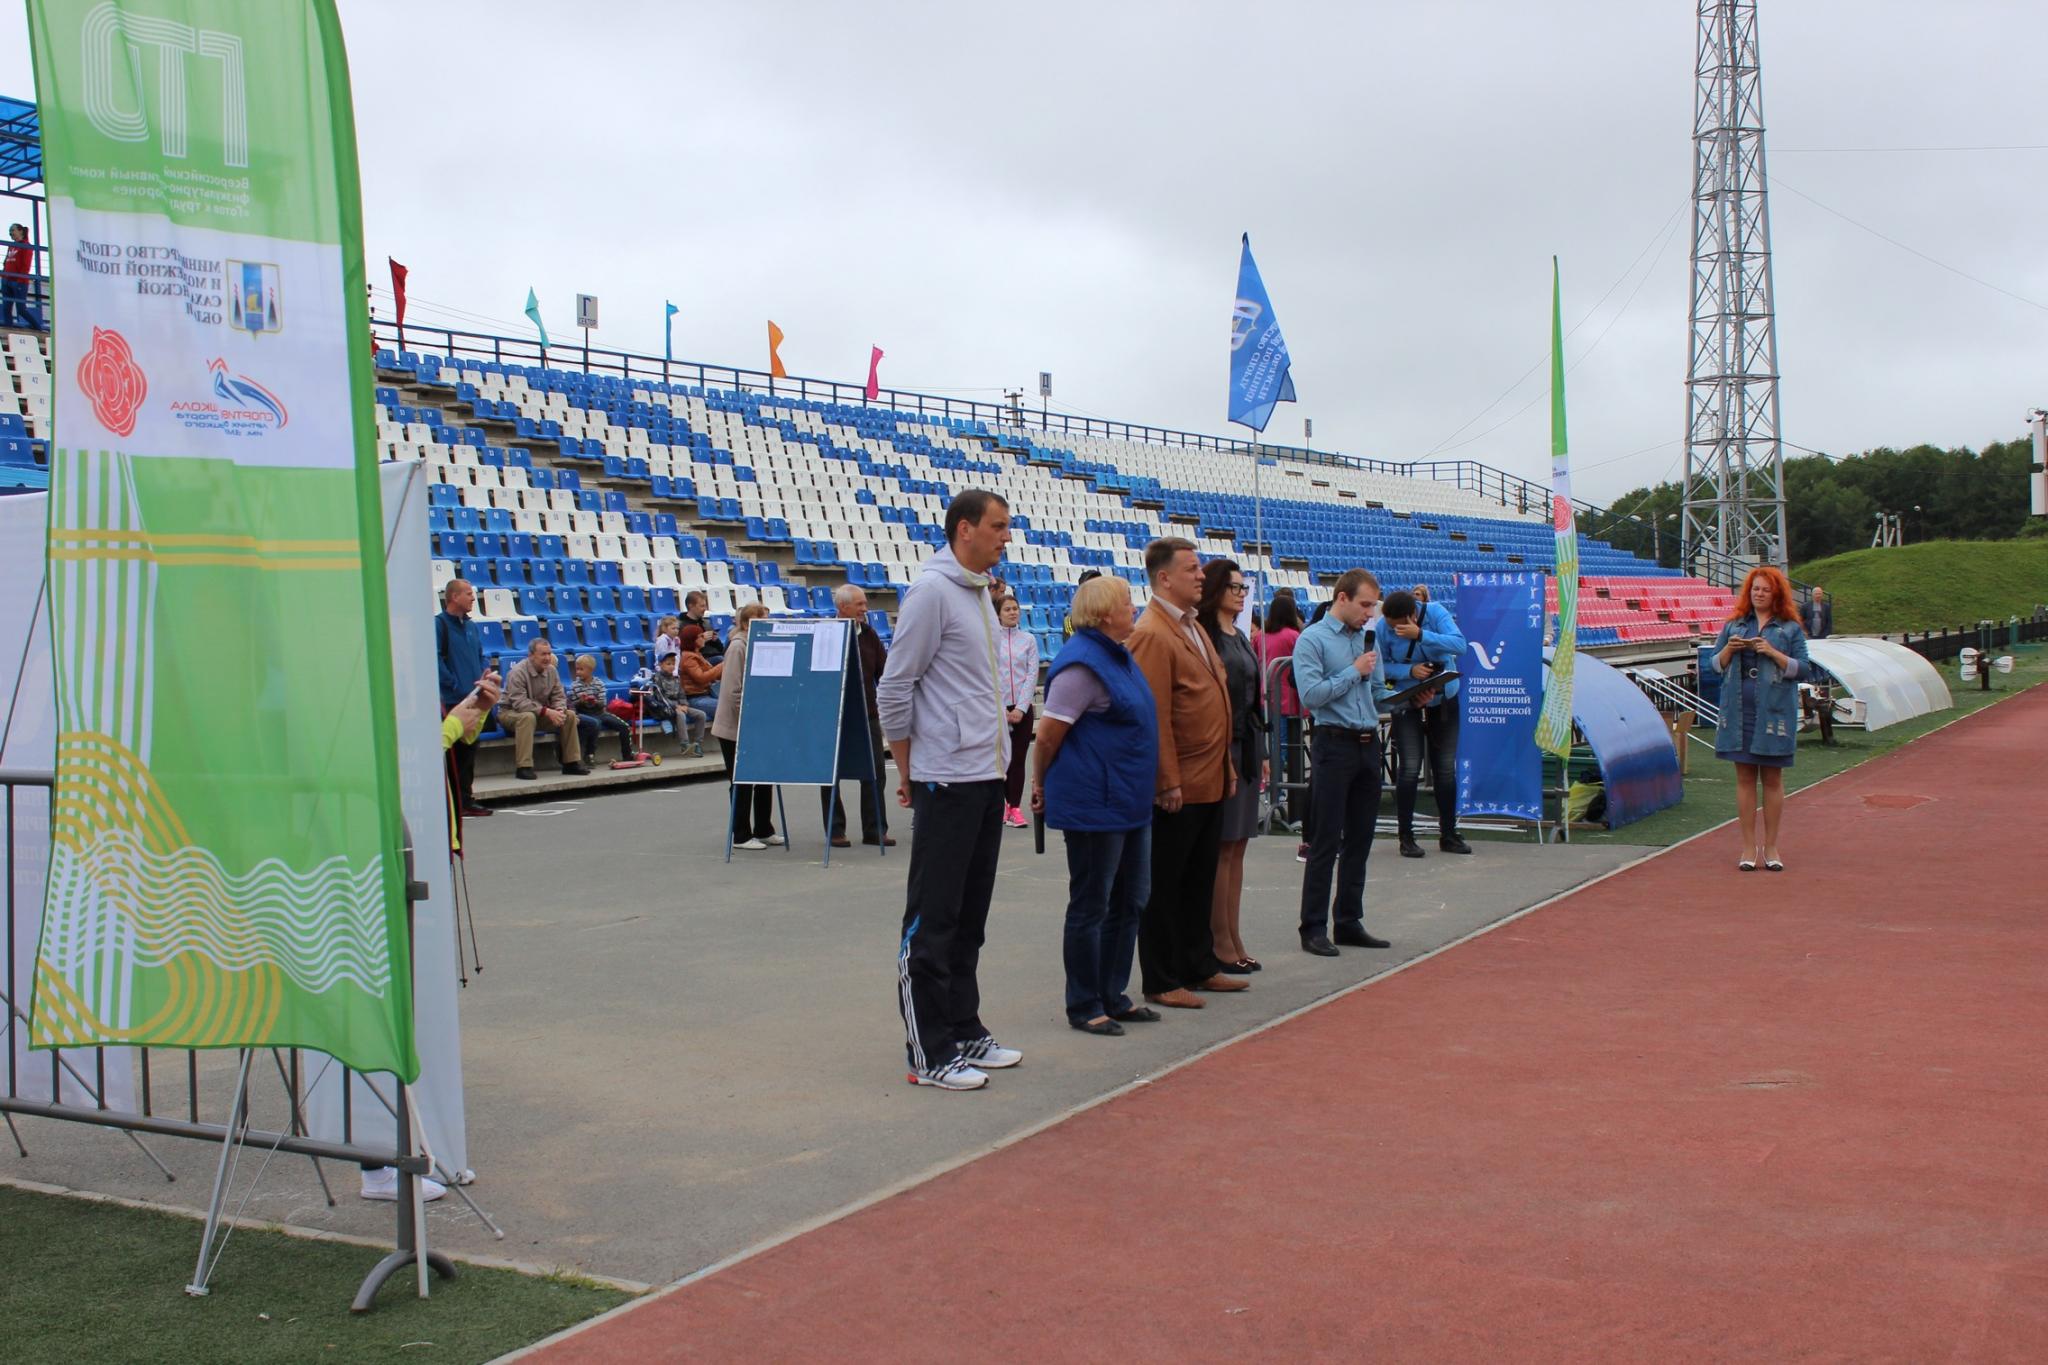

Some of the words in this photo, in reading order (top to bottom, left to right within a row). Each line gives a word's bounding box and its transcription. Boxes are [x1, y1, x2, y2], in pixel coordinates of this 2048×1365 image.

[1469, 677, 1523, 685] УПРАВЛЕНИЕ
[1468, 687, 1526, 695] СПОРТИВНЫХ
[1469, 695, 1531, 704] МЕРОПРИЯТИЙ
[1468, 706, 1531, 715] САХАЛИНСКОЙ
[1468, 716, 1506, 724] ОБЛАСТИ
